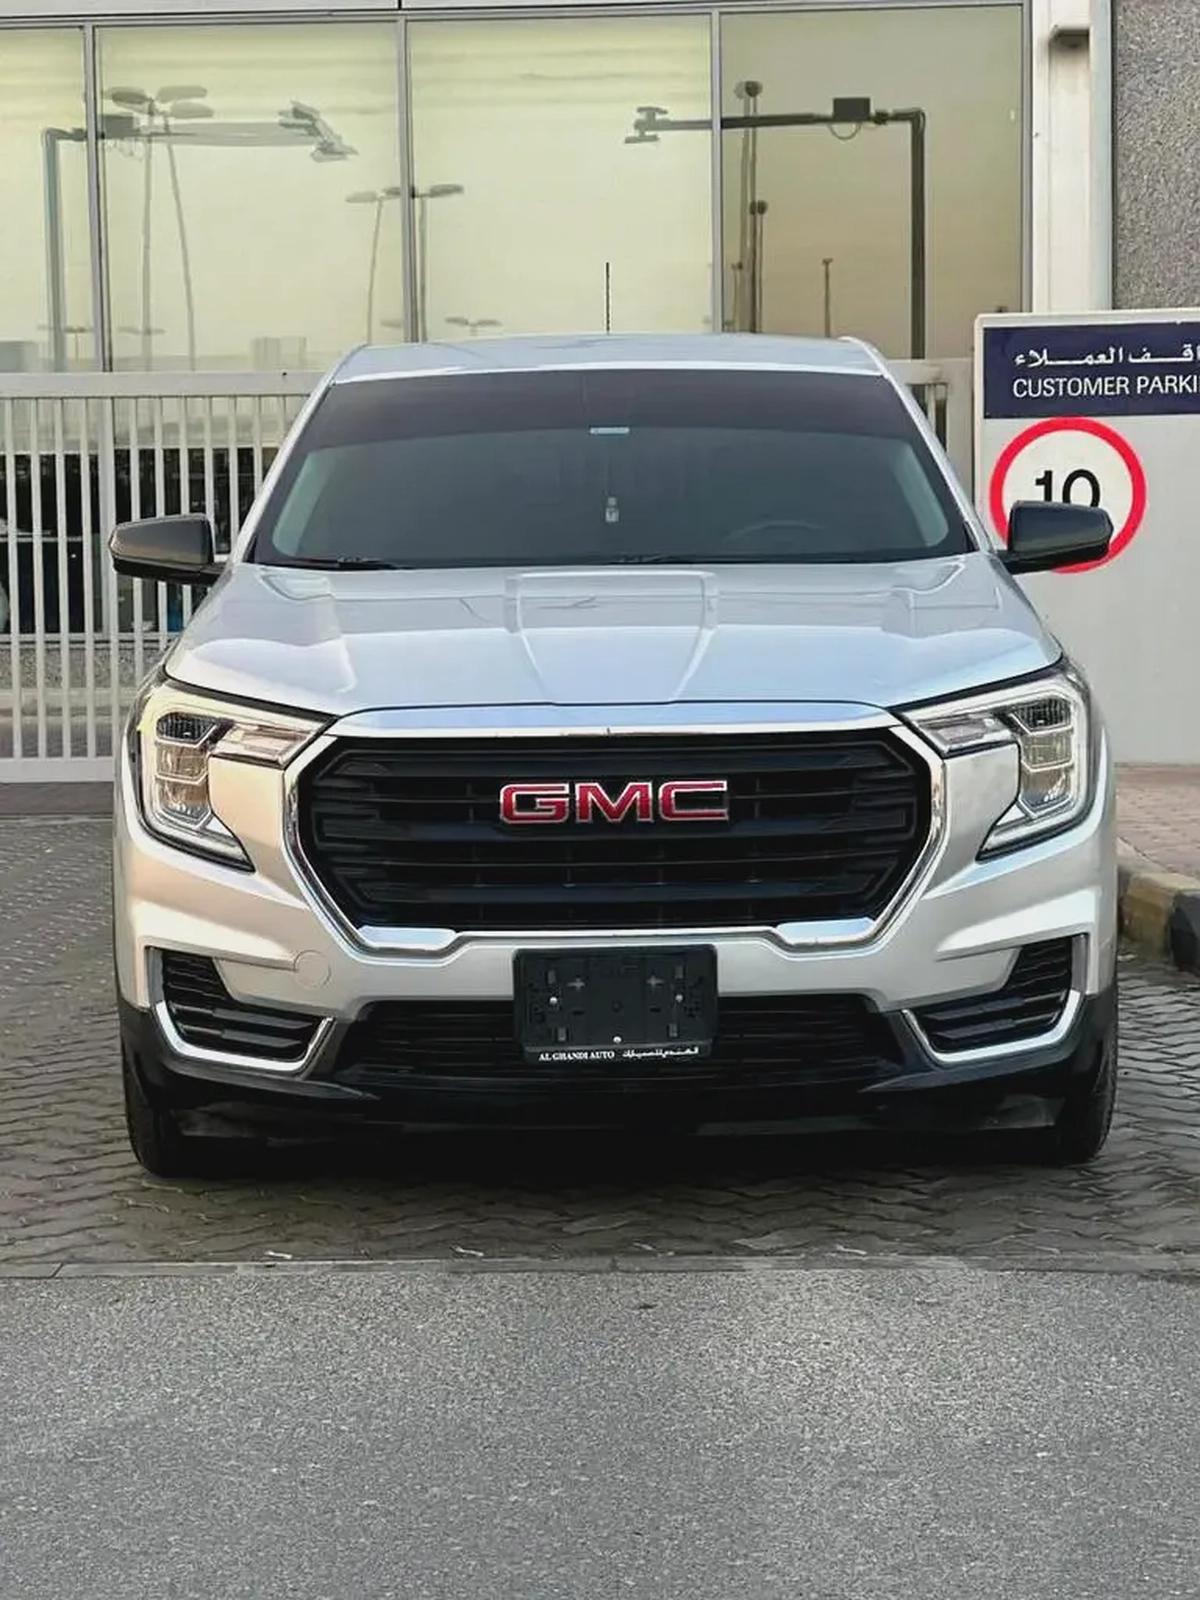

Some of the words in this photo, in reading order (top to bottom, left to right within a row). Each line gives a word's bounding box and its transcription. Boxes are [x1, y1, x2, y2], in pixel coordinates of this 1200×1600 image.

[1013, 376, 1130, 398] CUSTOMER
[1136, 374, 1200, 395] PARKI
[1035, 468, 1101, 508] 10
[500, 780, 729, 823] GMC
[538, 1052, 551, 1061] AL
[590, 1050, 615, 1060] AUTO
